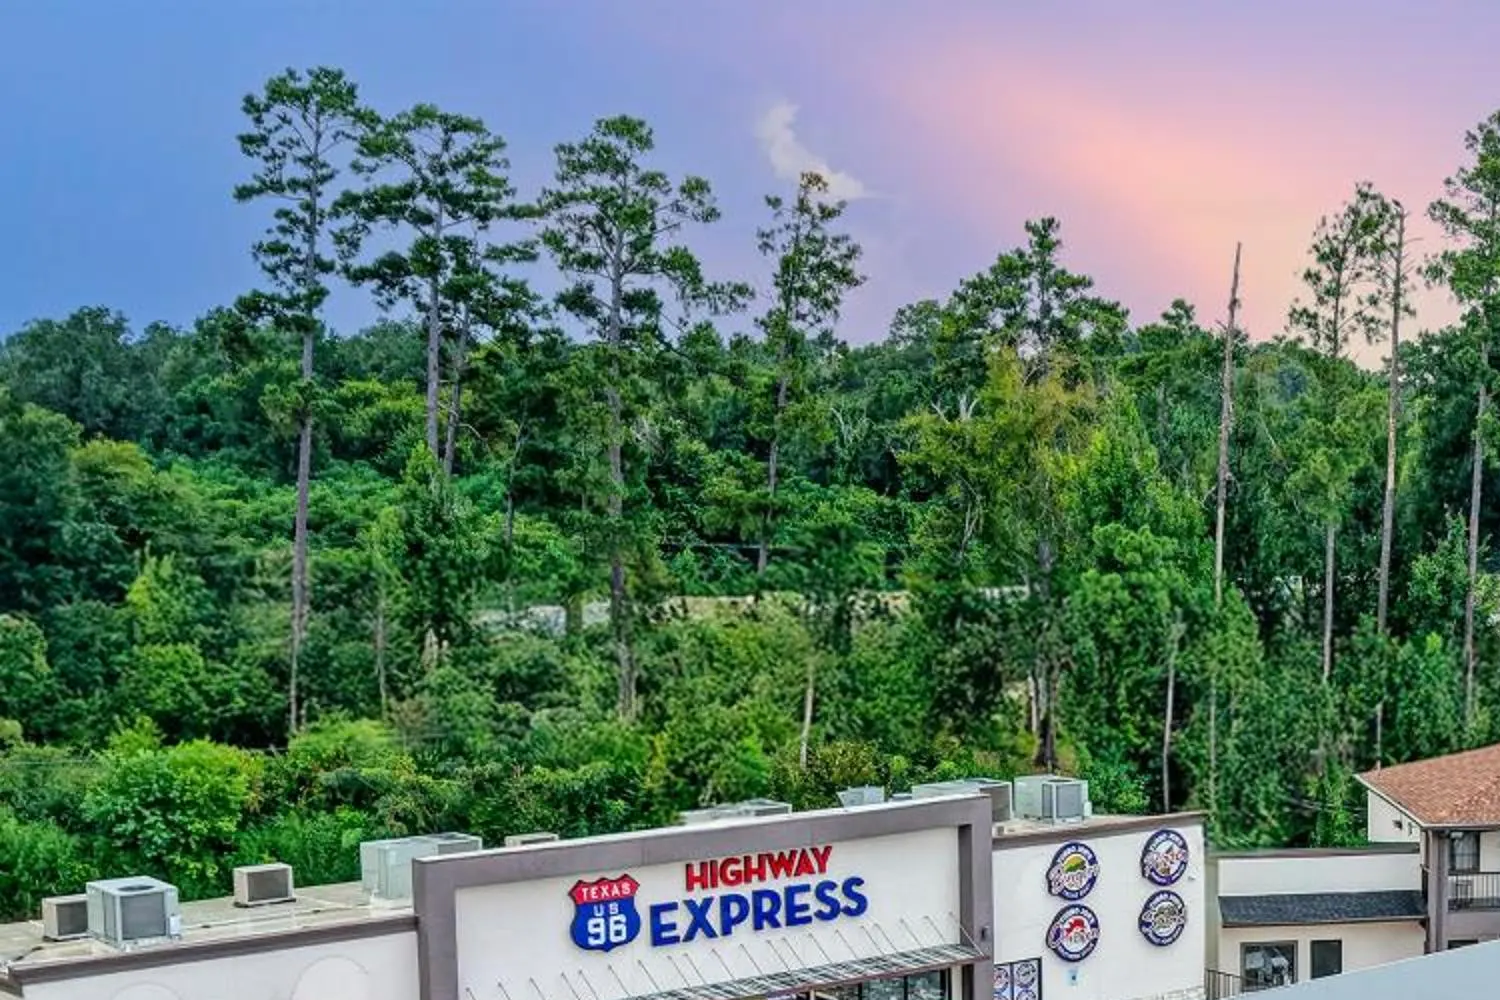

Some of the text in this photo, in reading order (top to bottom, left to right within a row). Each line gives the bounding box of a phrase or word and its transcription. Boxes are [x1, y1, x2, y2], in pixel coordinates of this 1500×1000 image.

[685, 845, 833, 892] HIGHWAY
[581, 883, 631, 901] TEXAS
[593, 903, 618, 917] US
[649, 876, 868, 947] EXPRESS
[587, 915, 627, 945] 96
